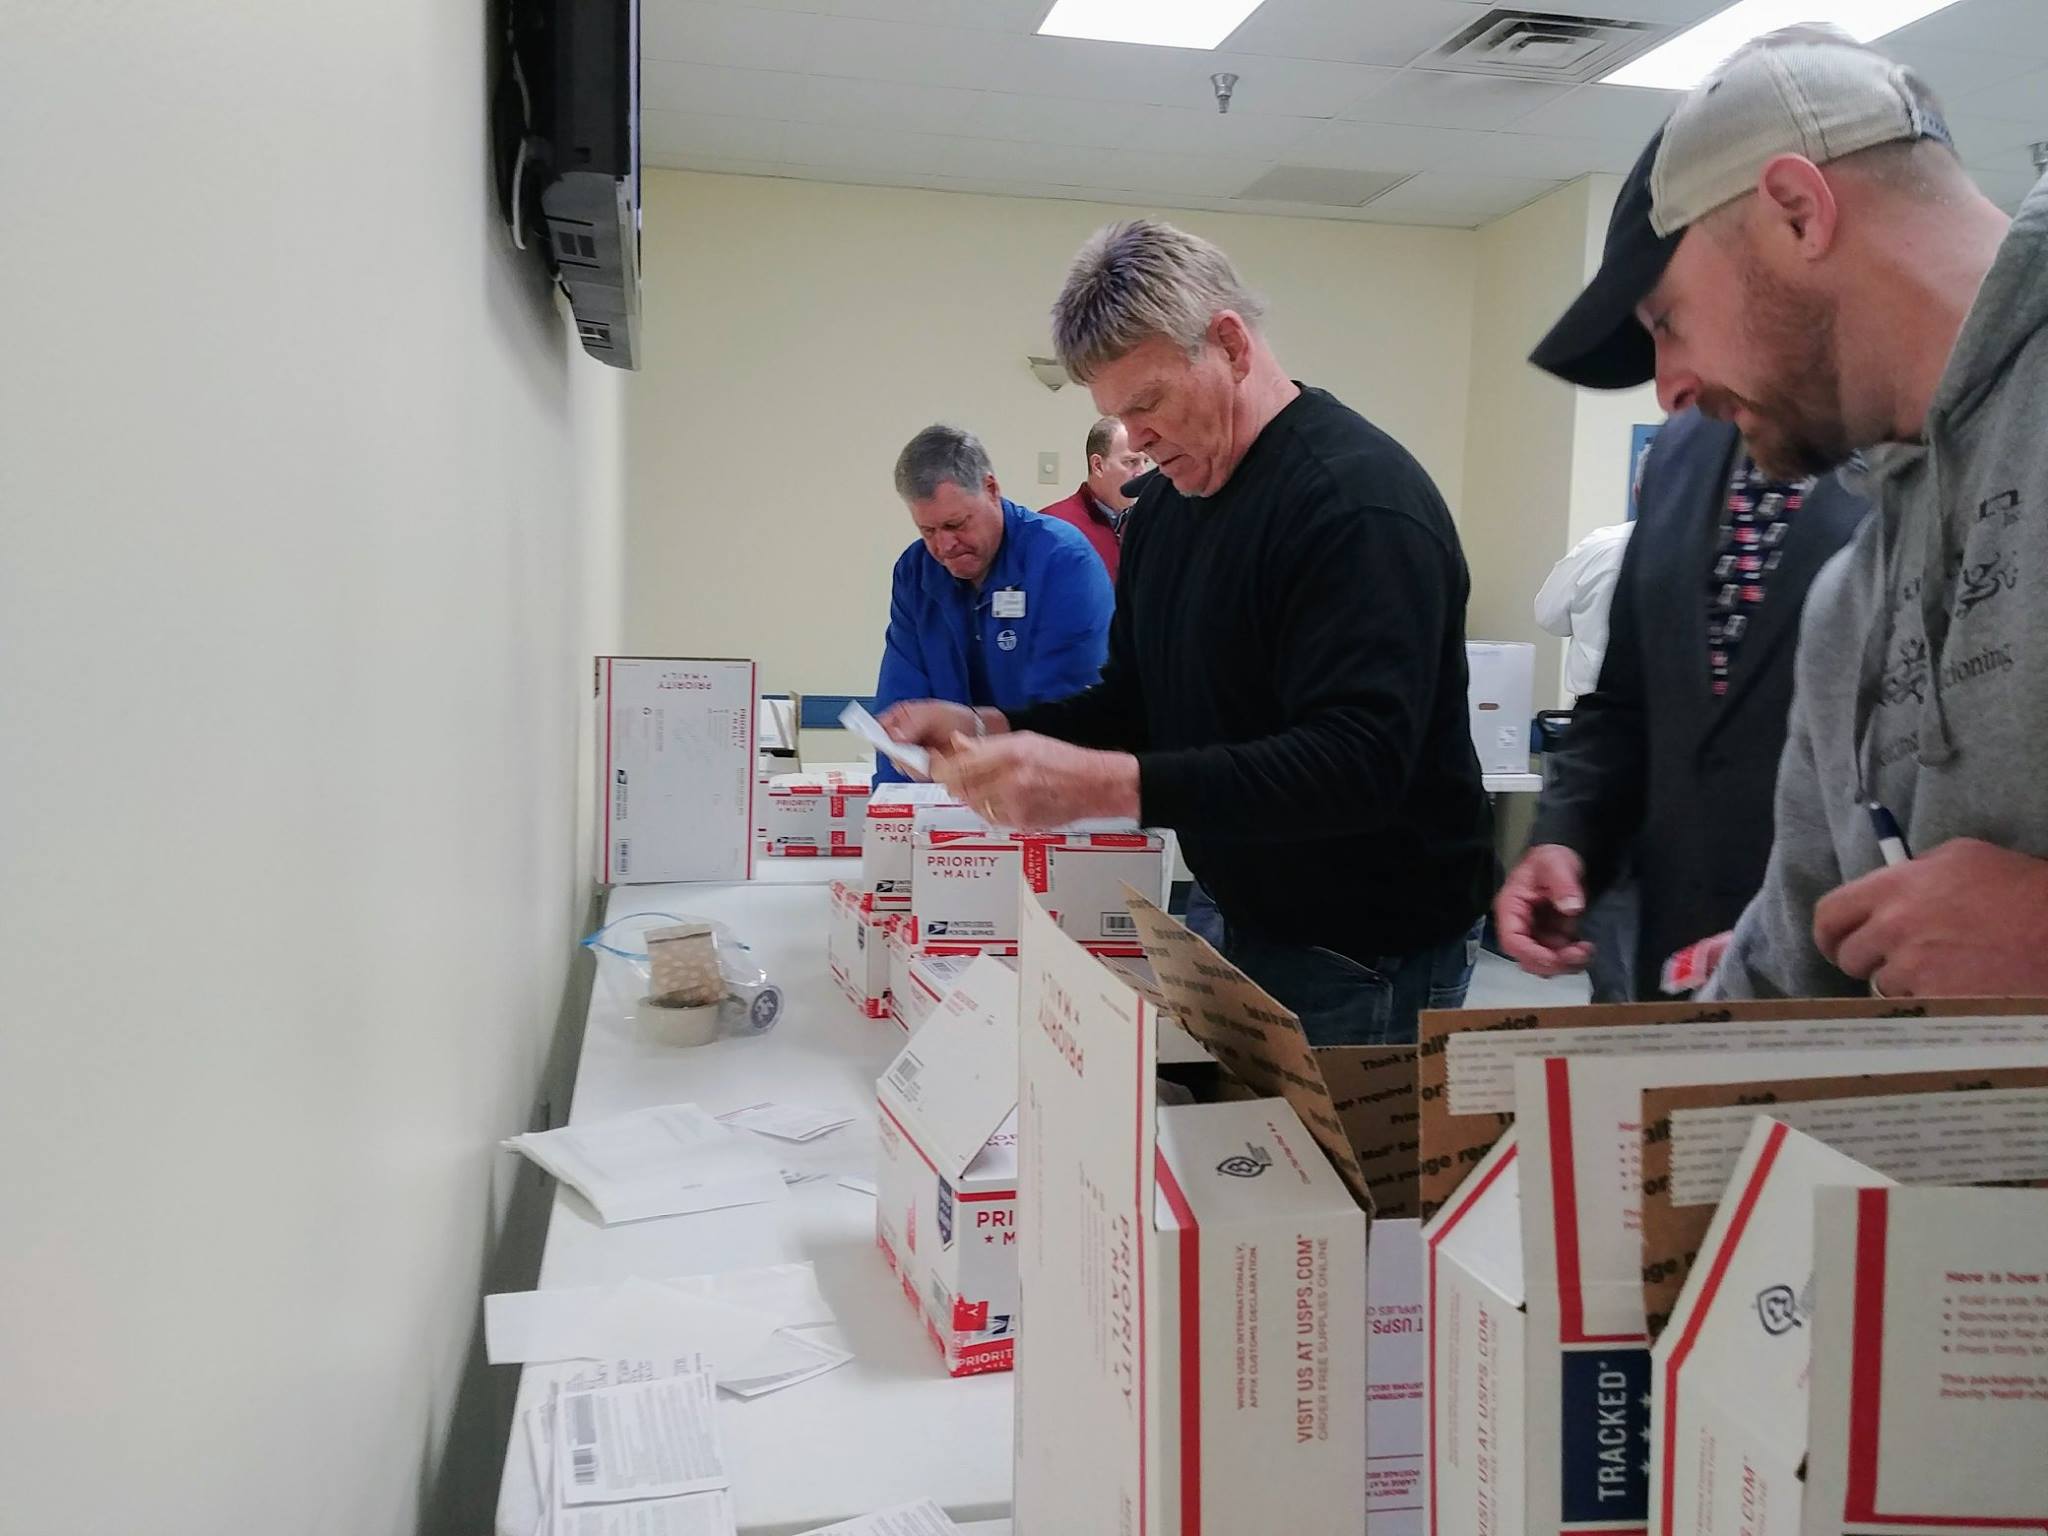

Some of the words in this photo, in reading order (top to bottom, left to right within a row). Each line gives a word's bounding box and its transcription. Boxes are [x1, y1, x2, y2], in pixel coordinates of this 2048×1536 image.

[927, 856, 998, 867] PRIORITY
[944, 869, 980, 878] MAIL
[1317, 1237, 1329, 1288] ONLINE
[1317, 1291, 1329, 1354] SUPPLIES
[1236, 1347, 1246, 1375] USED
[1249, 1326, 1258, 1376] CUSTOMS
[1297, 1340, 1314, 1362] AT
[1477, 1300, 1489, 1419] USPSCOM
[1297, 1367, 1314, 1392] US
[1317, 1357, 1329, 1391] FREE
[1236, 1376, 1246, 1410] WHEN
[1249, 1378, 1258, 1409] AFFIX
[1297, 1398, 1314, 1443] VISIT
[1317, 1394, 1329, 1441] ORDER
[1477, 1425, 1489, 1451] AT
[1477, 1454, 1489, 1484] US
